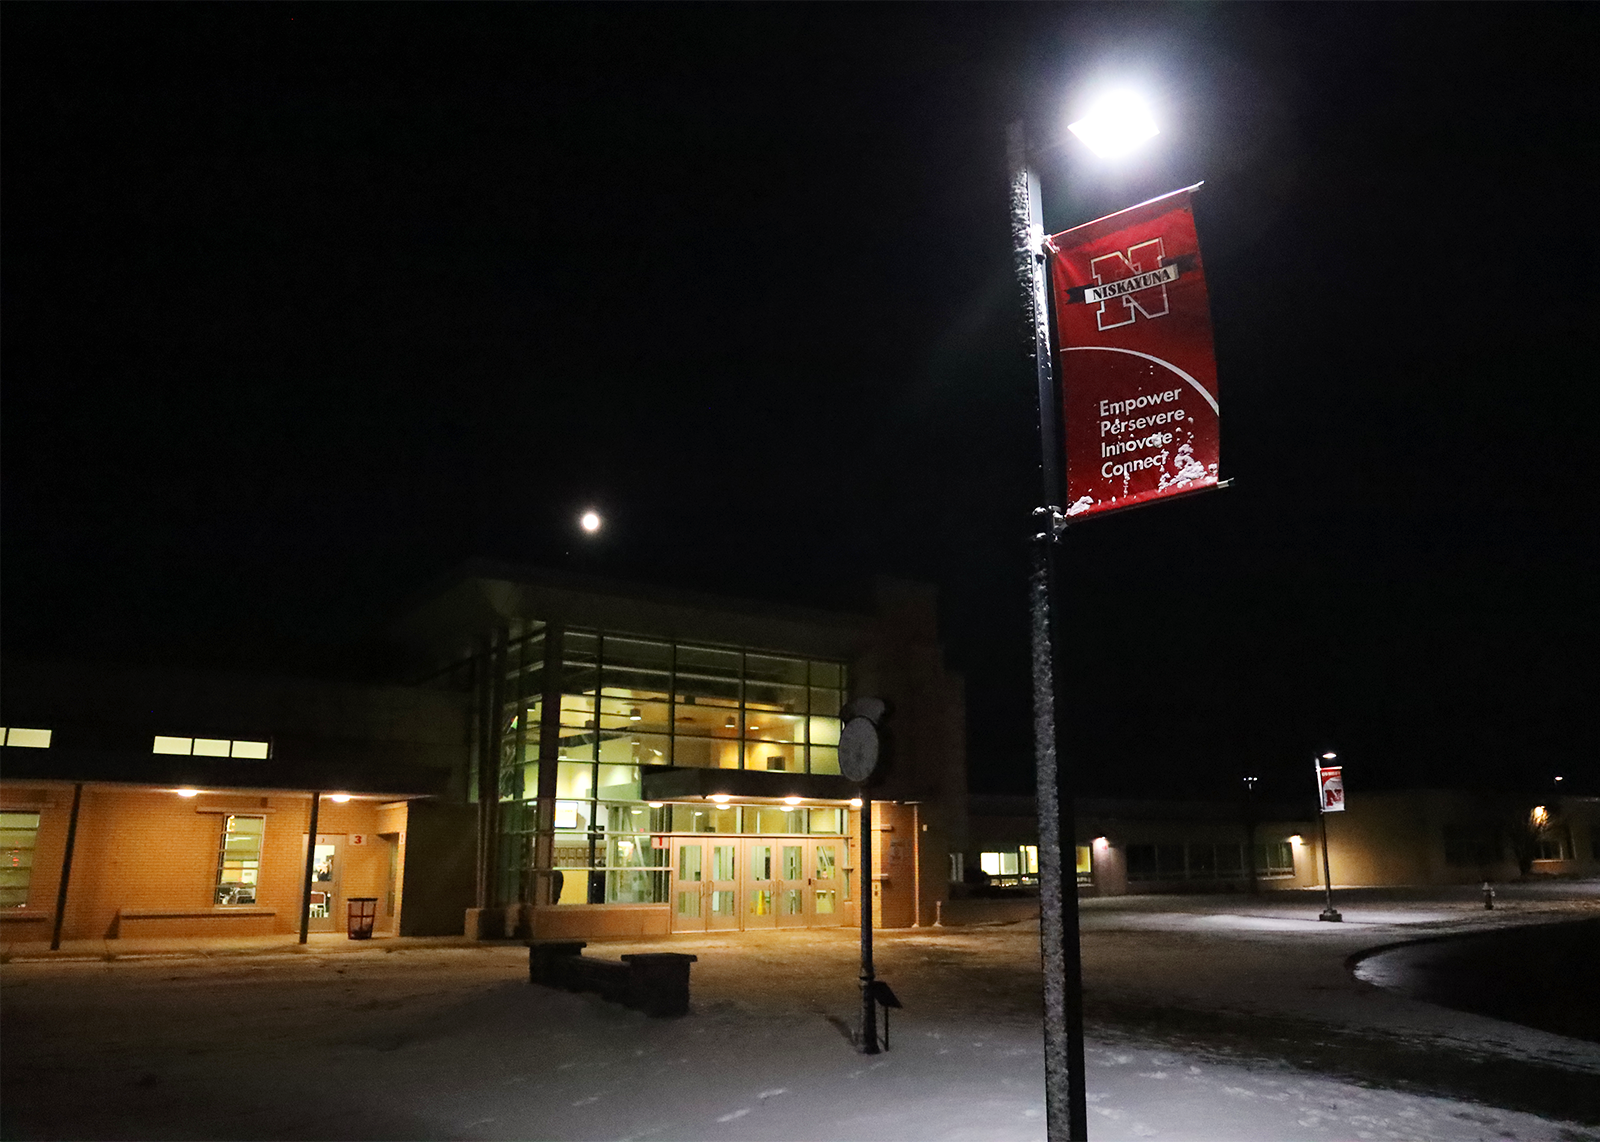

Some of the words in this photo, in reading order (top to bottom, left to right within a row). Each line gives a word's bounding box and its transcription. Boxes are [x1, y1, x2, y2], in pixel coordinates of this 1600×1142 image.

[1092, 269, 1171, 300] NISKAYUNA
[1099, 388, 1182, 417] Empower
[1100, 409, 1185, 437] Persevere
[1325, 789, 1342, 806] N
[354, 835, 362, 844] 3
